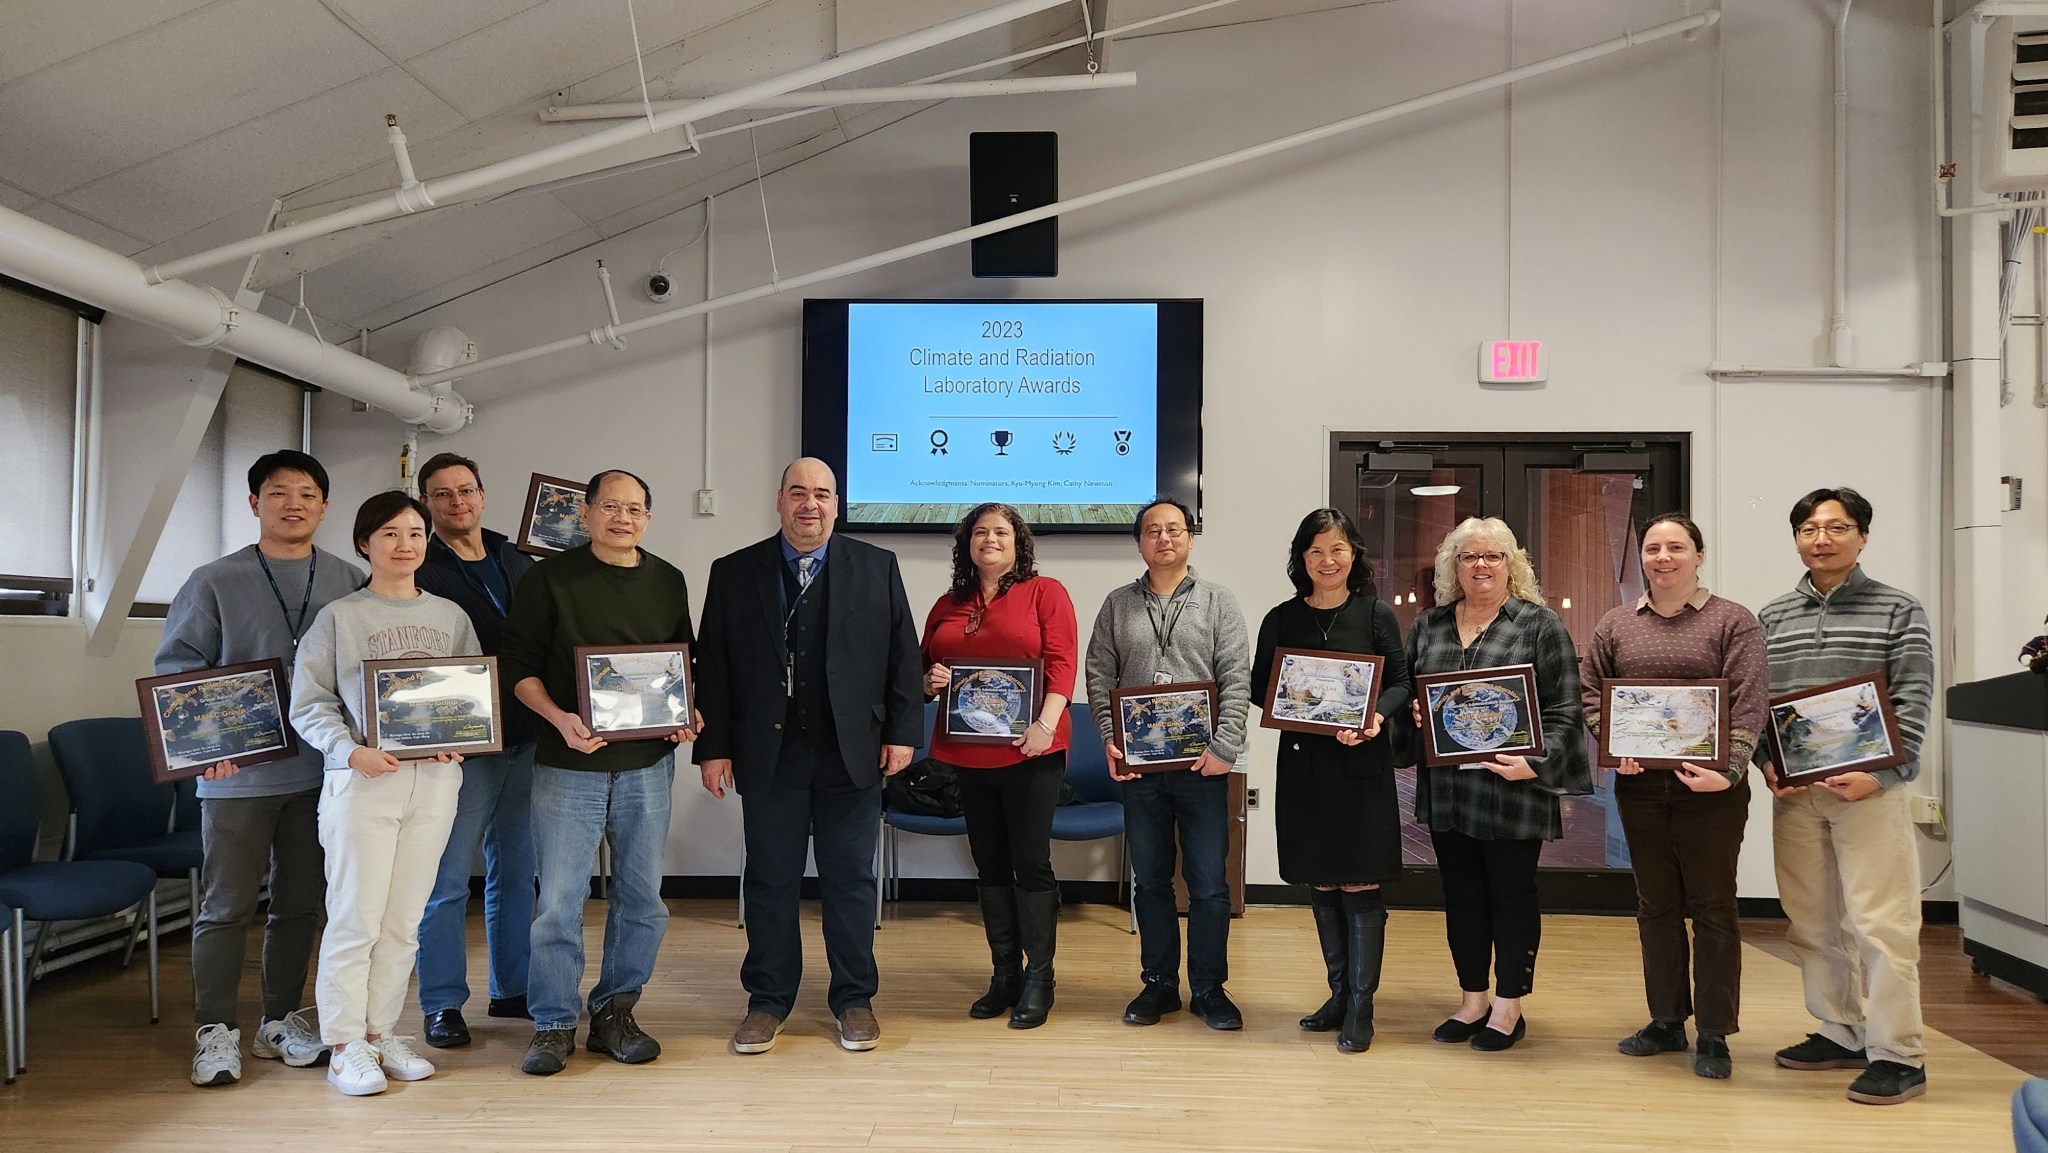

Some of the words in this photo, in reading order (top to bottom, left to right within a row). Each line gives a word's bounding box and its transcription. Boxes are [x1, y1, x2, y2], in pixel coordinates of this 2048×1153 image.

[981, 320, 1023, 339] 2023
[909, 347, 973, 366] Climate
[979, 348, 1010, 366] and
[1016, 347, 1095, 366] Radiation
[1492, 341, 1541, 378] EXIT
[924, 375, 1013, 398] Laboratory
[1018, 375, 1081, 394] Awards
[909, 479, 969, 488] Acknowledgments:
[1010, 480, 1046, 489] Kyu-Myong
[1063, 480, 1083, 489] Cathy
[367, 625, 451, 659] STANFORD
